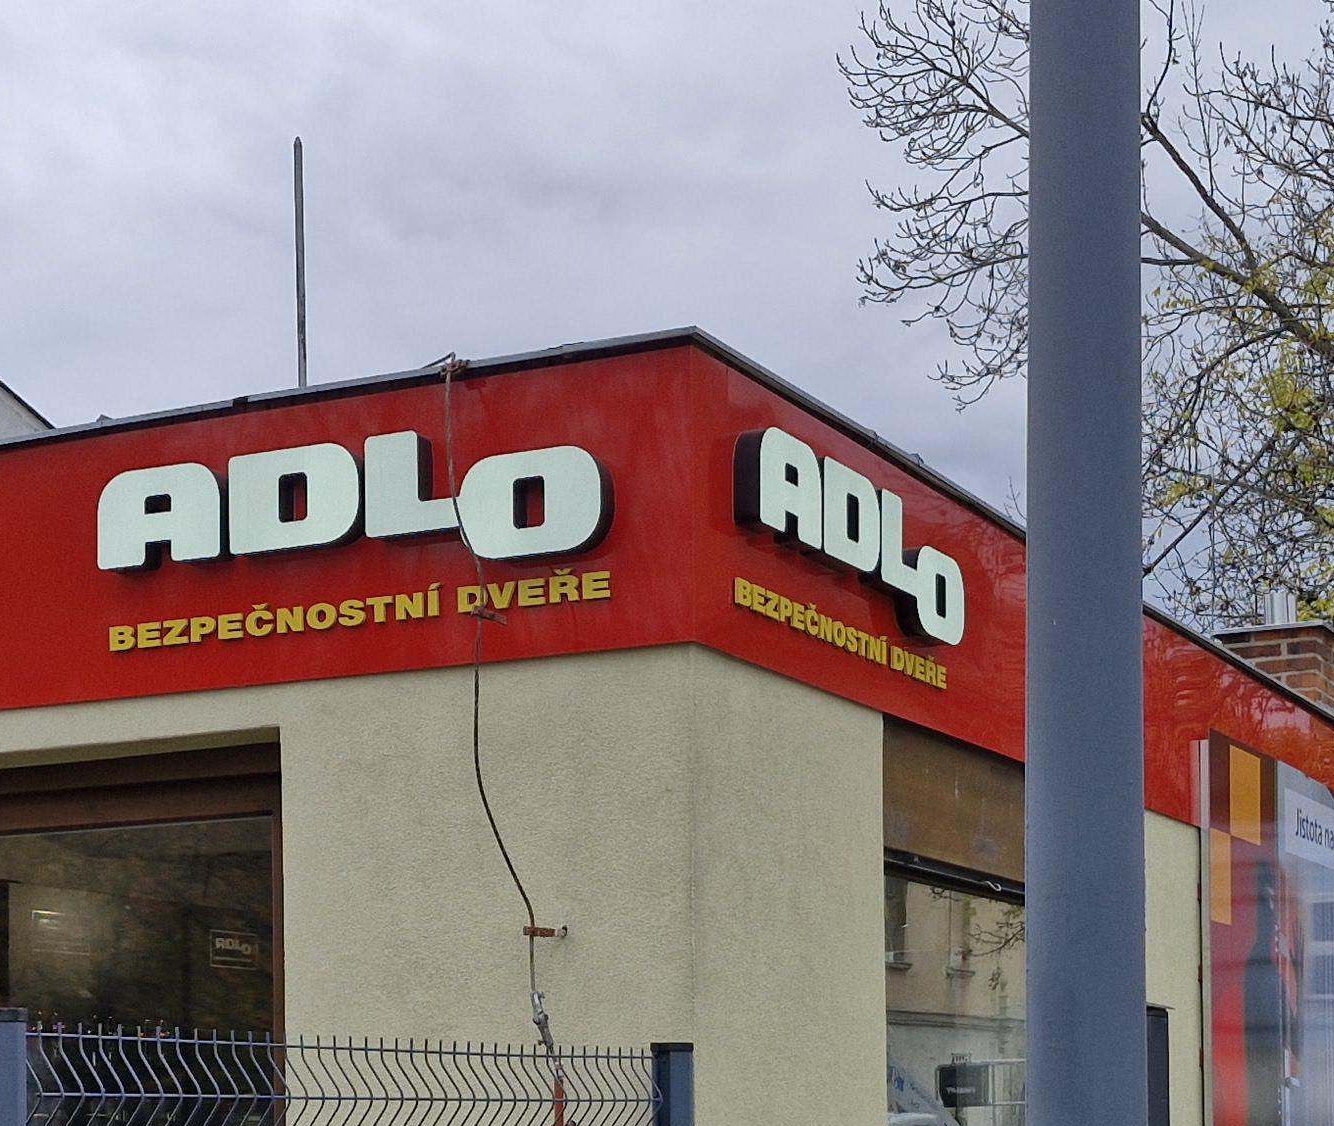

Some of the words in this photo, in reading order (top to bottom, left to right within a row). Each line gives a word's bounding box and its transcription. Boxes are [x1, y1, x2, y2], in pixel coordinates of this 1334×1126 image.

[96, 430, 611, 571] ADLO
[757, 425, 966, 646] ADLO
[108, 582, 440, 652] BEZPEČNOSTNÍ
[457, 568, 612, 614] DVEŘE
[733, 576, 887, 667] BEZPEČNOSTNÍ
[890, 644, 948, 689] DVEŘE
[1295, 807, 1323, 846] Jistota
[1324, 827, 1334, 851] na
